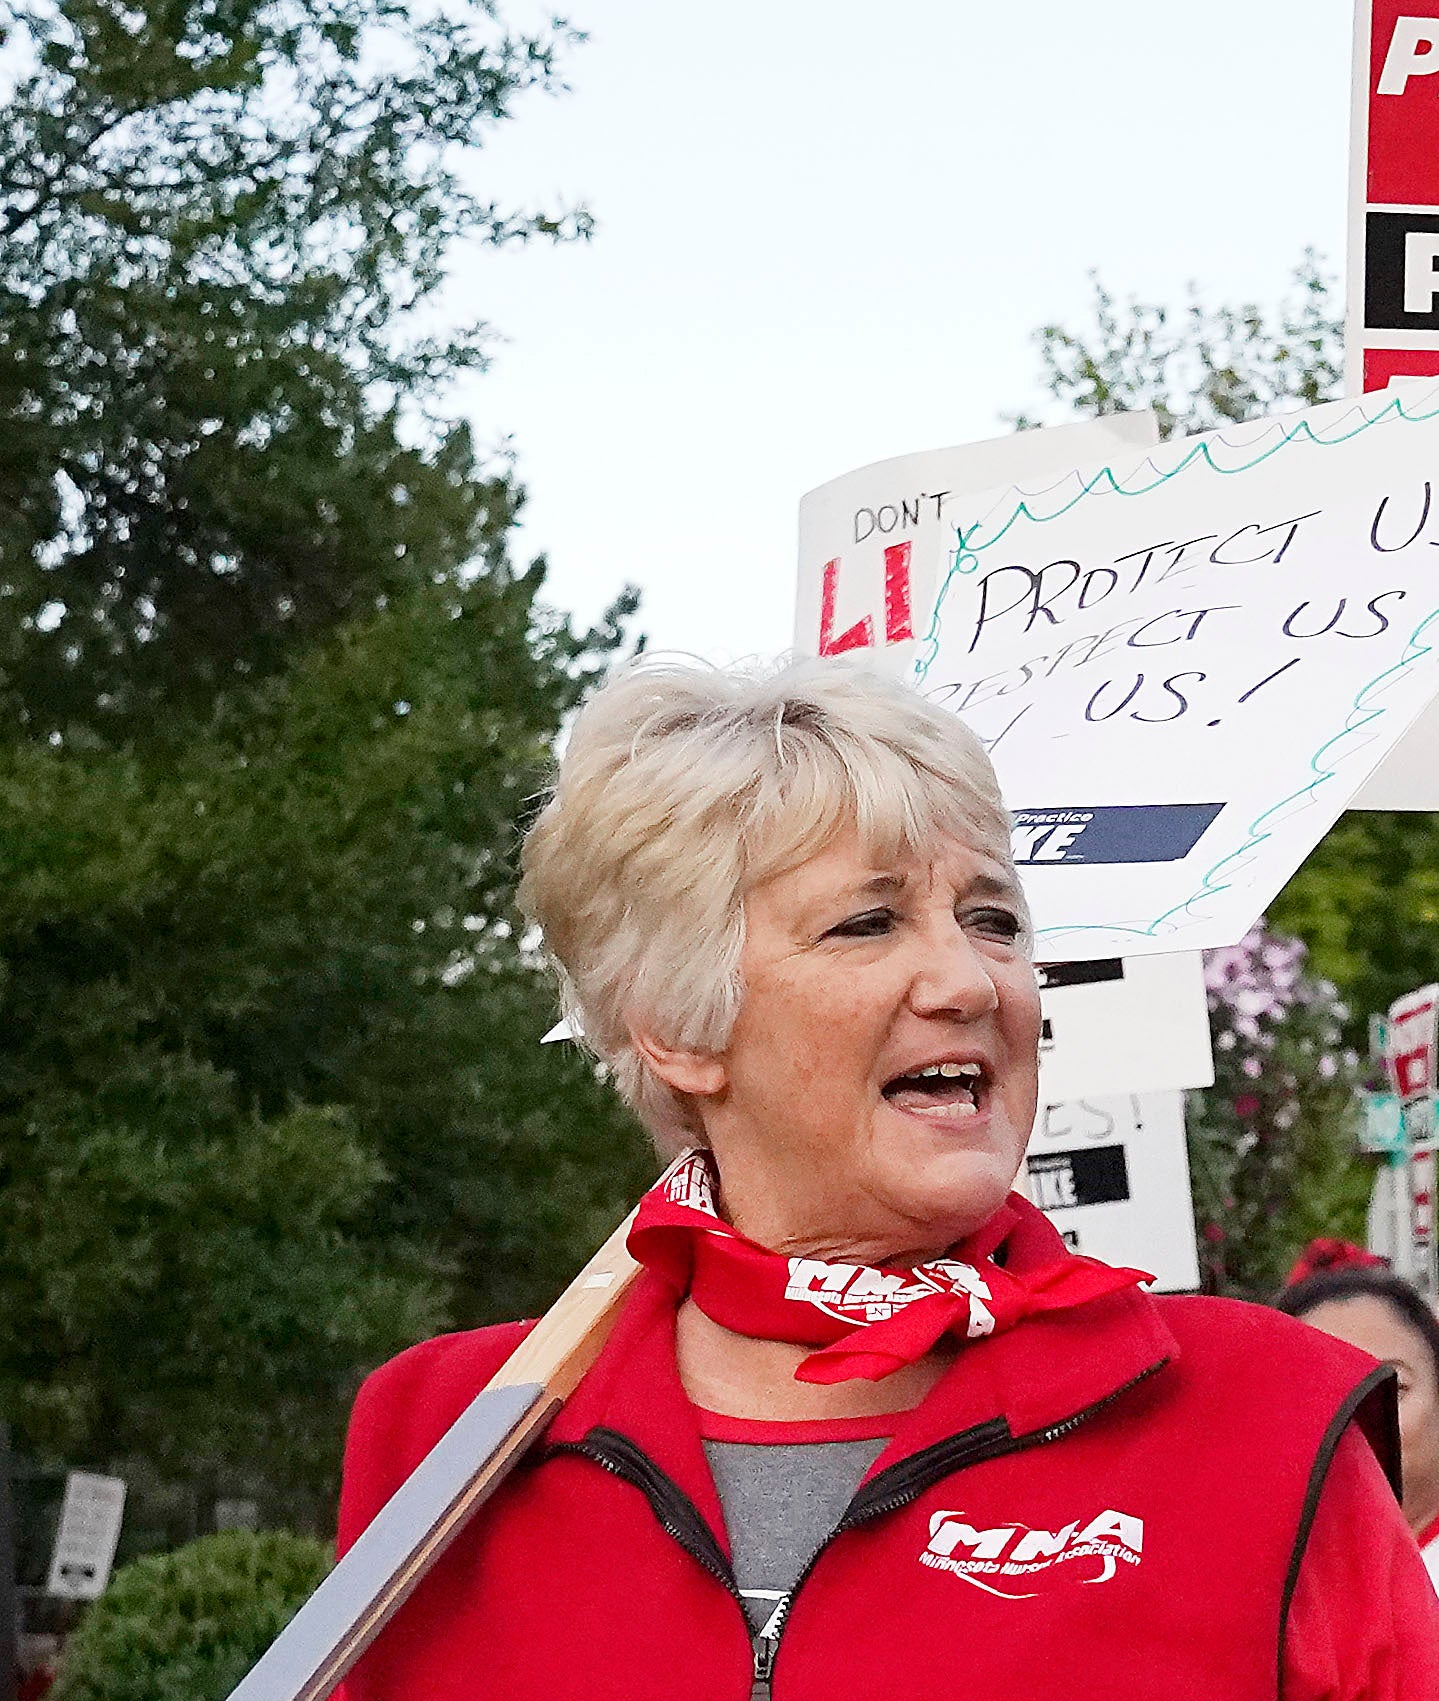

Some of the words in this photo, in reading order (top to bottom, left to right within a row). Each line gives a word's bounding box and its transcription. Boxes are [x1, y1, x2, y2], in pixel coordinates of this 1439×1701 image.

[855, 490, 952, 544] DON'T
[819, 541, 914, 658] LI
[1282, 591, 1406, 638] US
[1010, 824, 1087, 861] KE
[927, 1509, 1144, 1562] MNA
